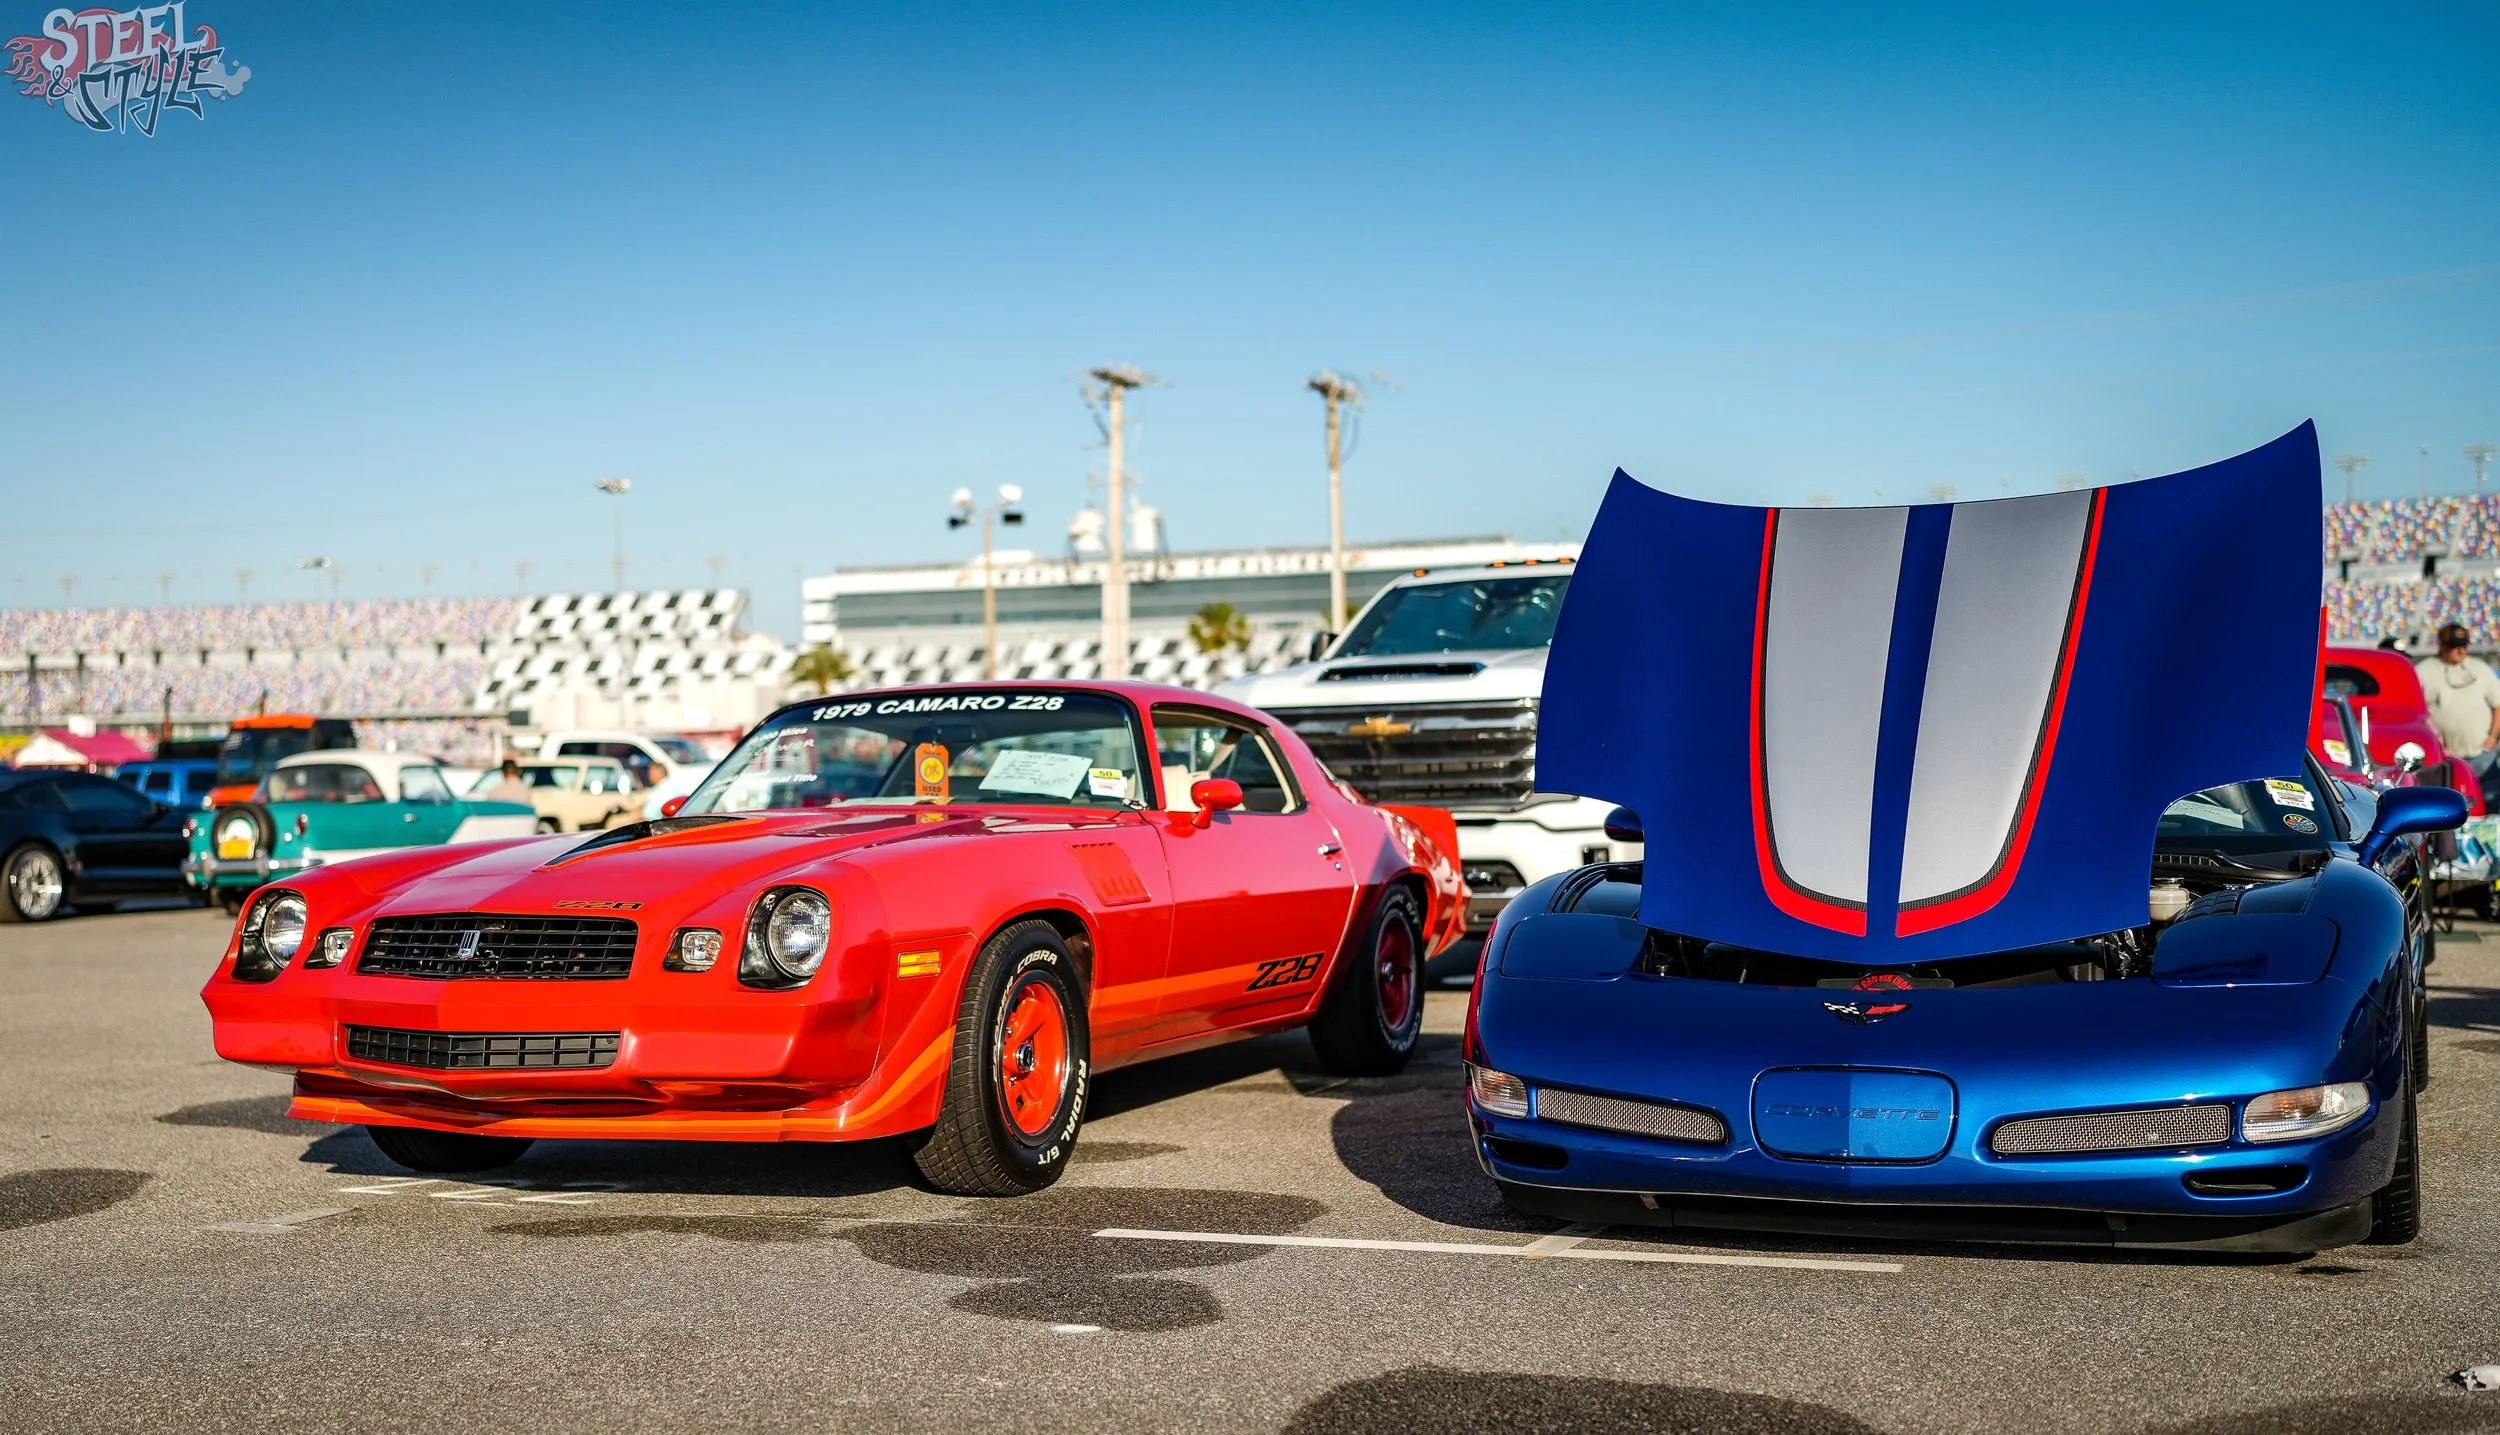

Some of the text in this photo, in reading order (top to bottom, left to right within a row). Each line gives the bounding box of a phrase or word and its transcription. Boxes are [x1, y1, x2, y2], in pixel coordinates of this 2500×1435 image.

[812, 696, 1065, 721] 1979 CAMARO Z28
[922, 785, 942, 793] USED
[552, 900, 644, 911] Z28
[1016, 950, 1058, 975] COBRA
[1244, 951, 1326, 992] Z28
[1037, 1058, 1087, 1165] RADIAL G/T
[1764, 1104, 1941, 1121] CORVETTE
